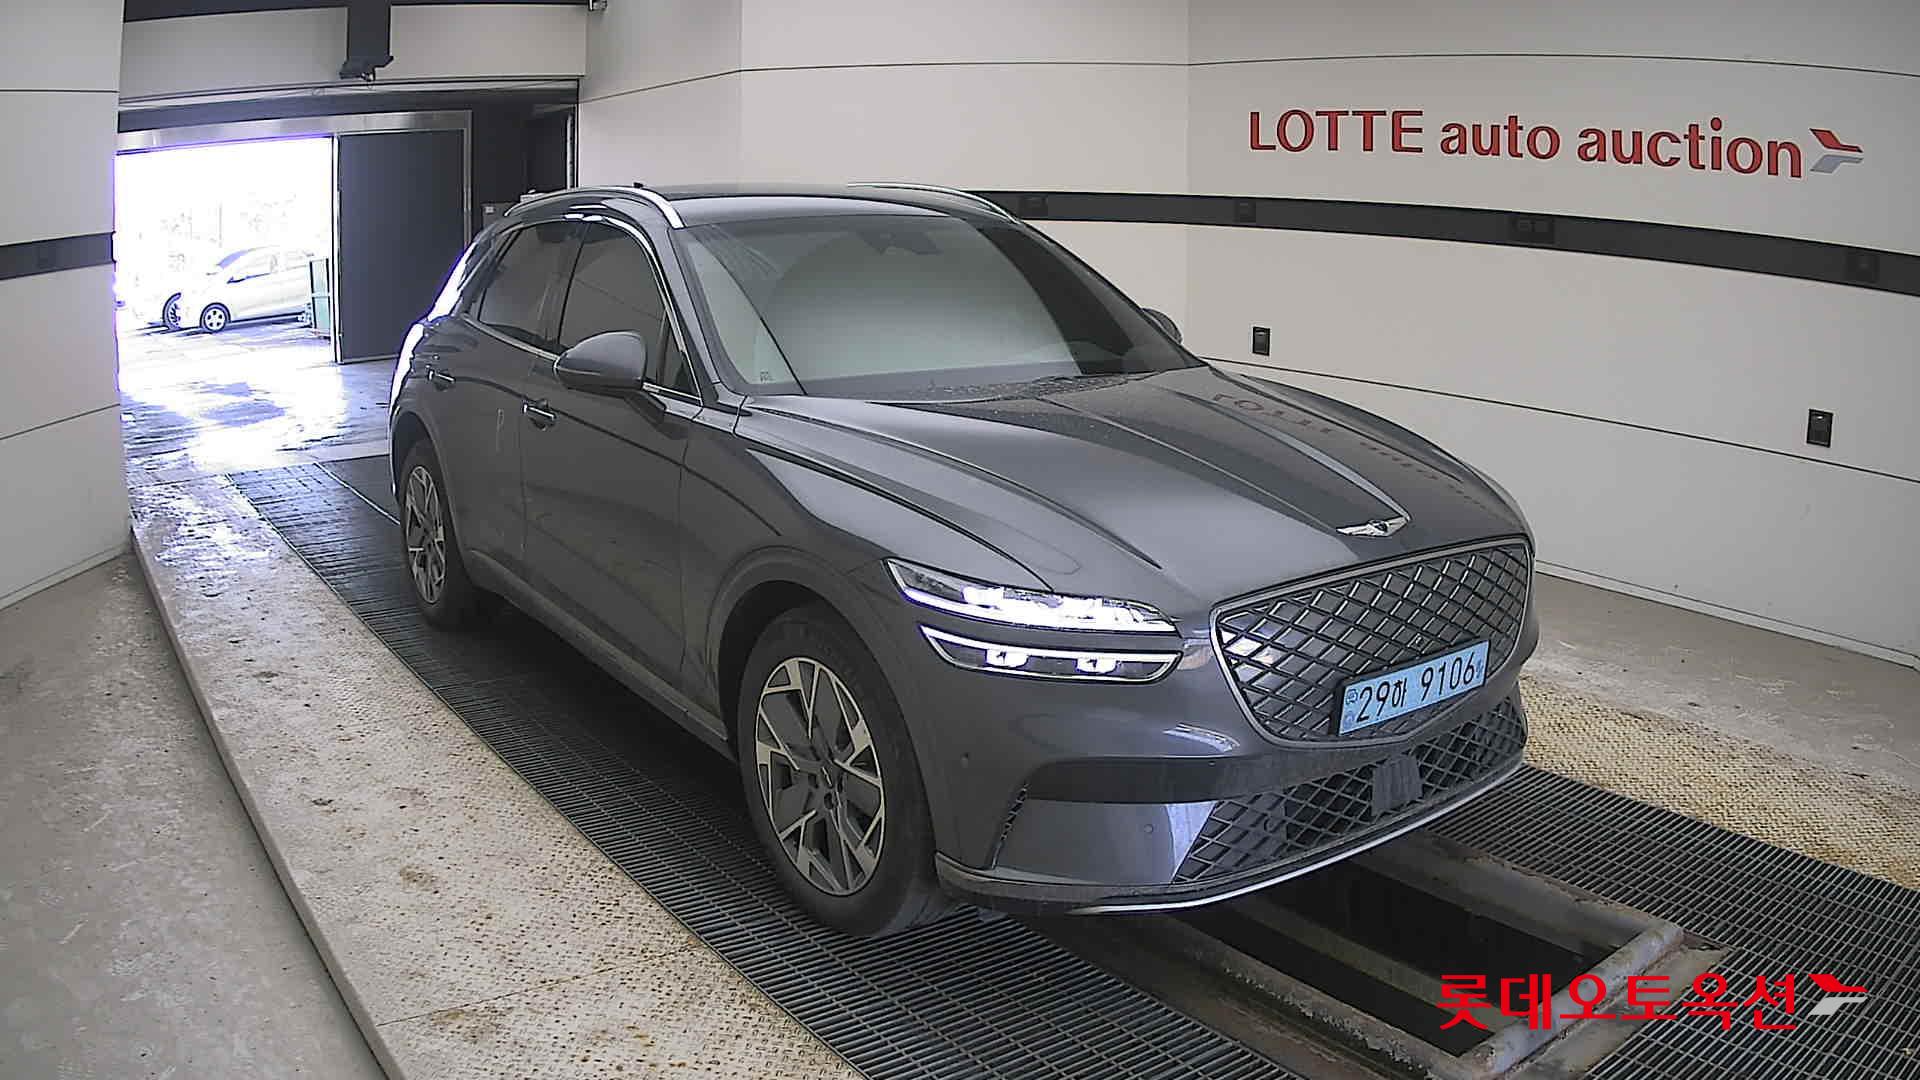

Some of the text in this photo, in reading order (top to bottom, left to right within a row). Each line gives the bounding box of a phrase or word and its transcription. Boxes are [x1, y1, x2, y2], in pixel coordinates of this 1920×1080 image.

[1249, 109, 1803, 178] LOTTE auto auction
[1356, 678, 1408, 723] 29하
[1421, 652, 1475, 702] 9106
